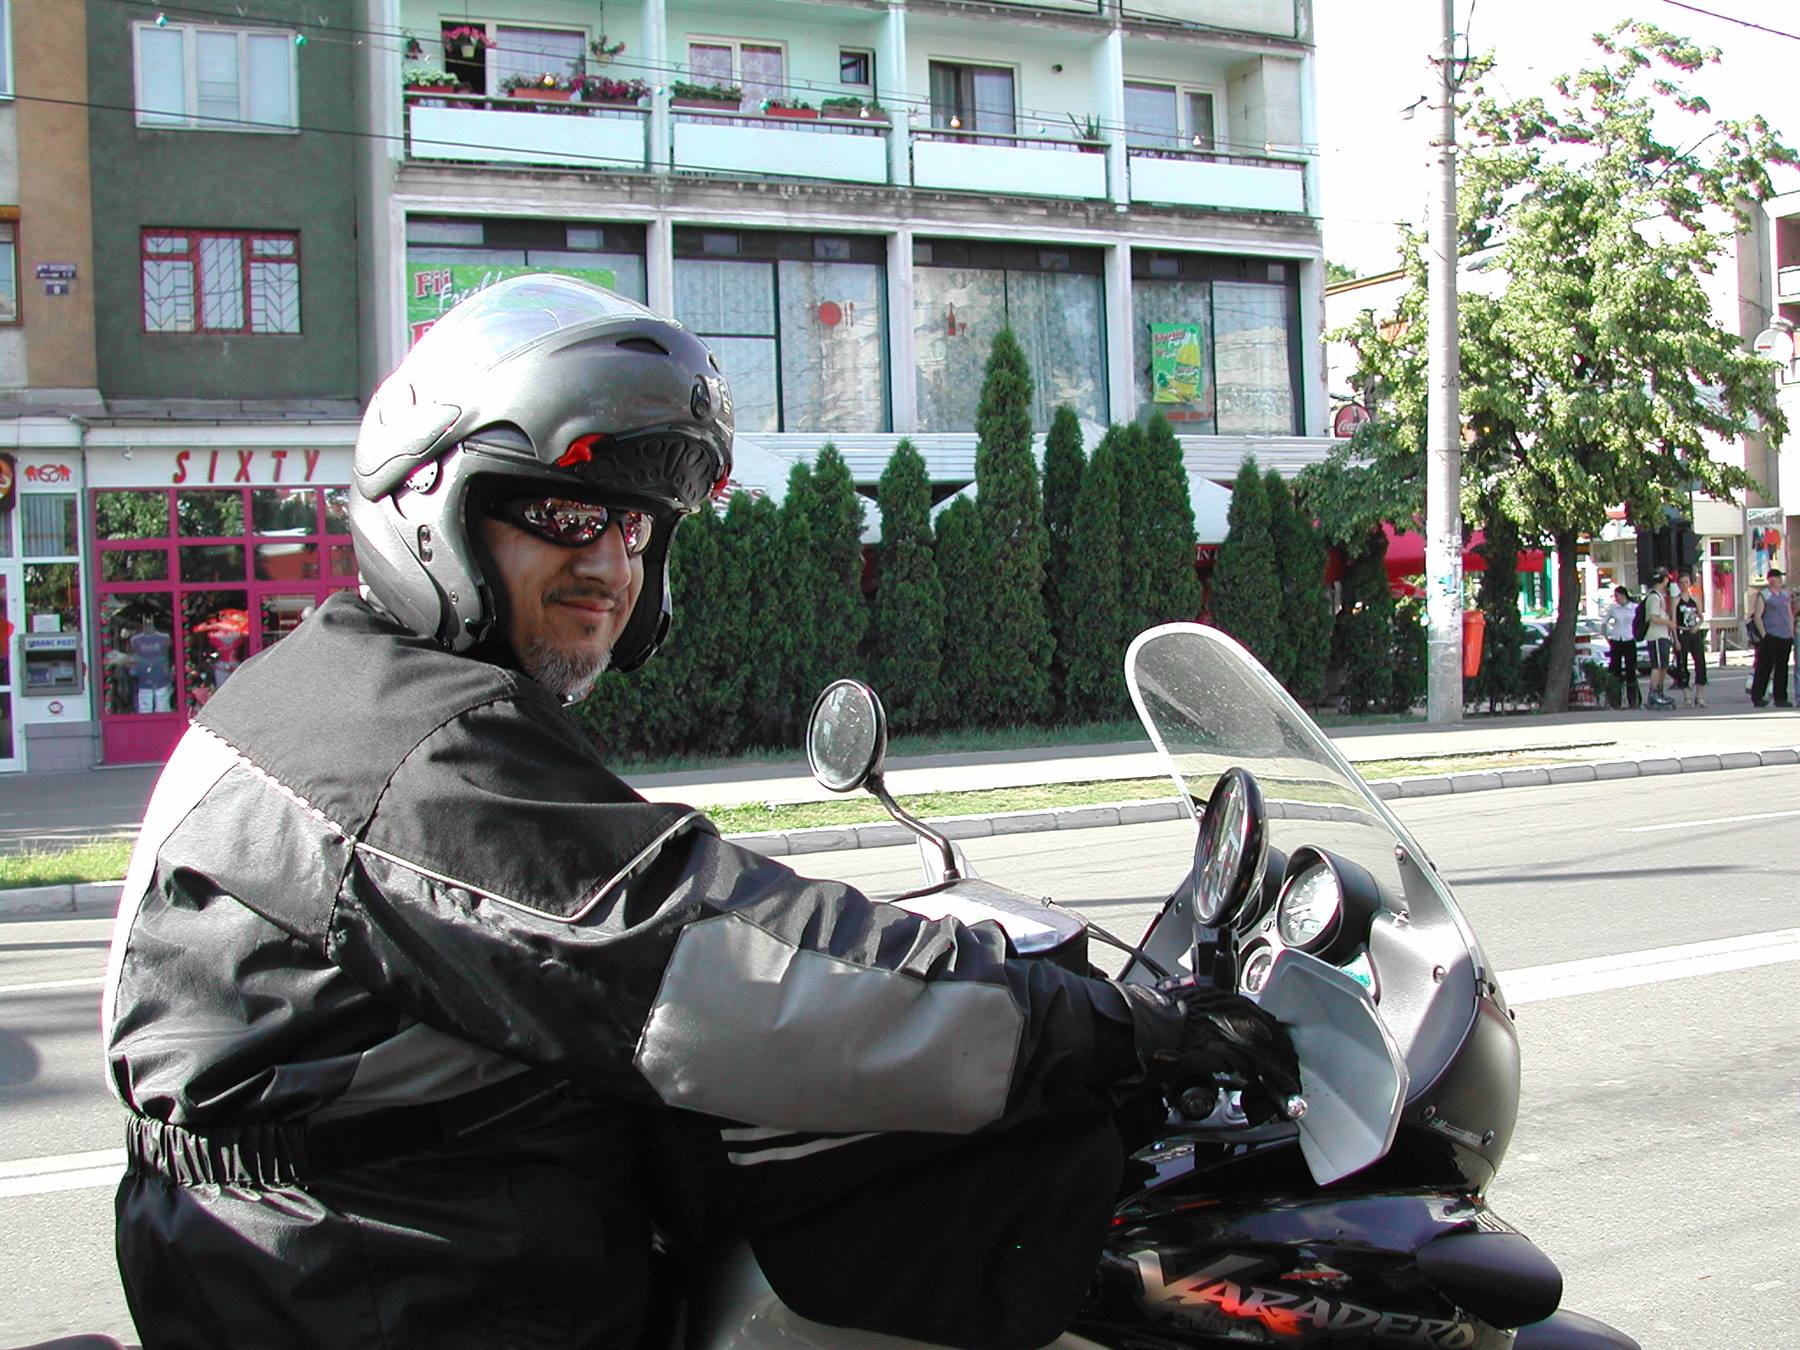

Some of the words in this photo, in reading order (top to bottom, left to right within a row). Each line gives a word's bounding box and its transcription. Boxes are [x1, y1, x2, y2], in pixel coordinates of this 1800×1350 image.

[415, 269, 453, 298] Fii
[172, 450, 320, 483] SIXTY
[57, 639, 76, 647] POST
[1128, 1250, 1475, 1349] VARADERO
